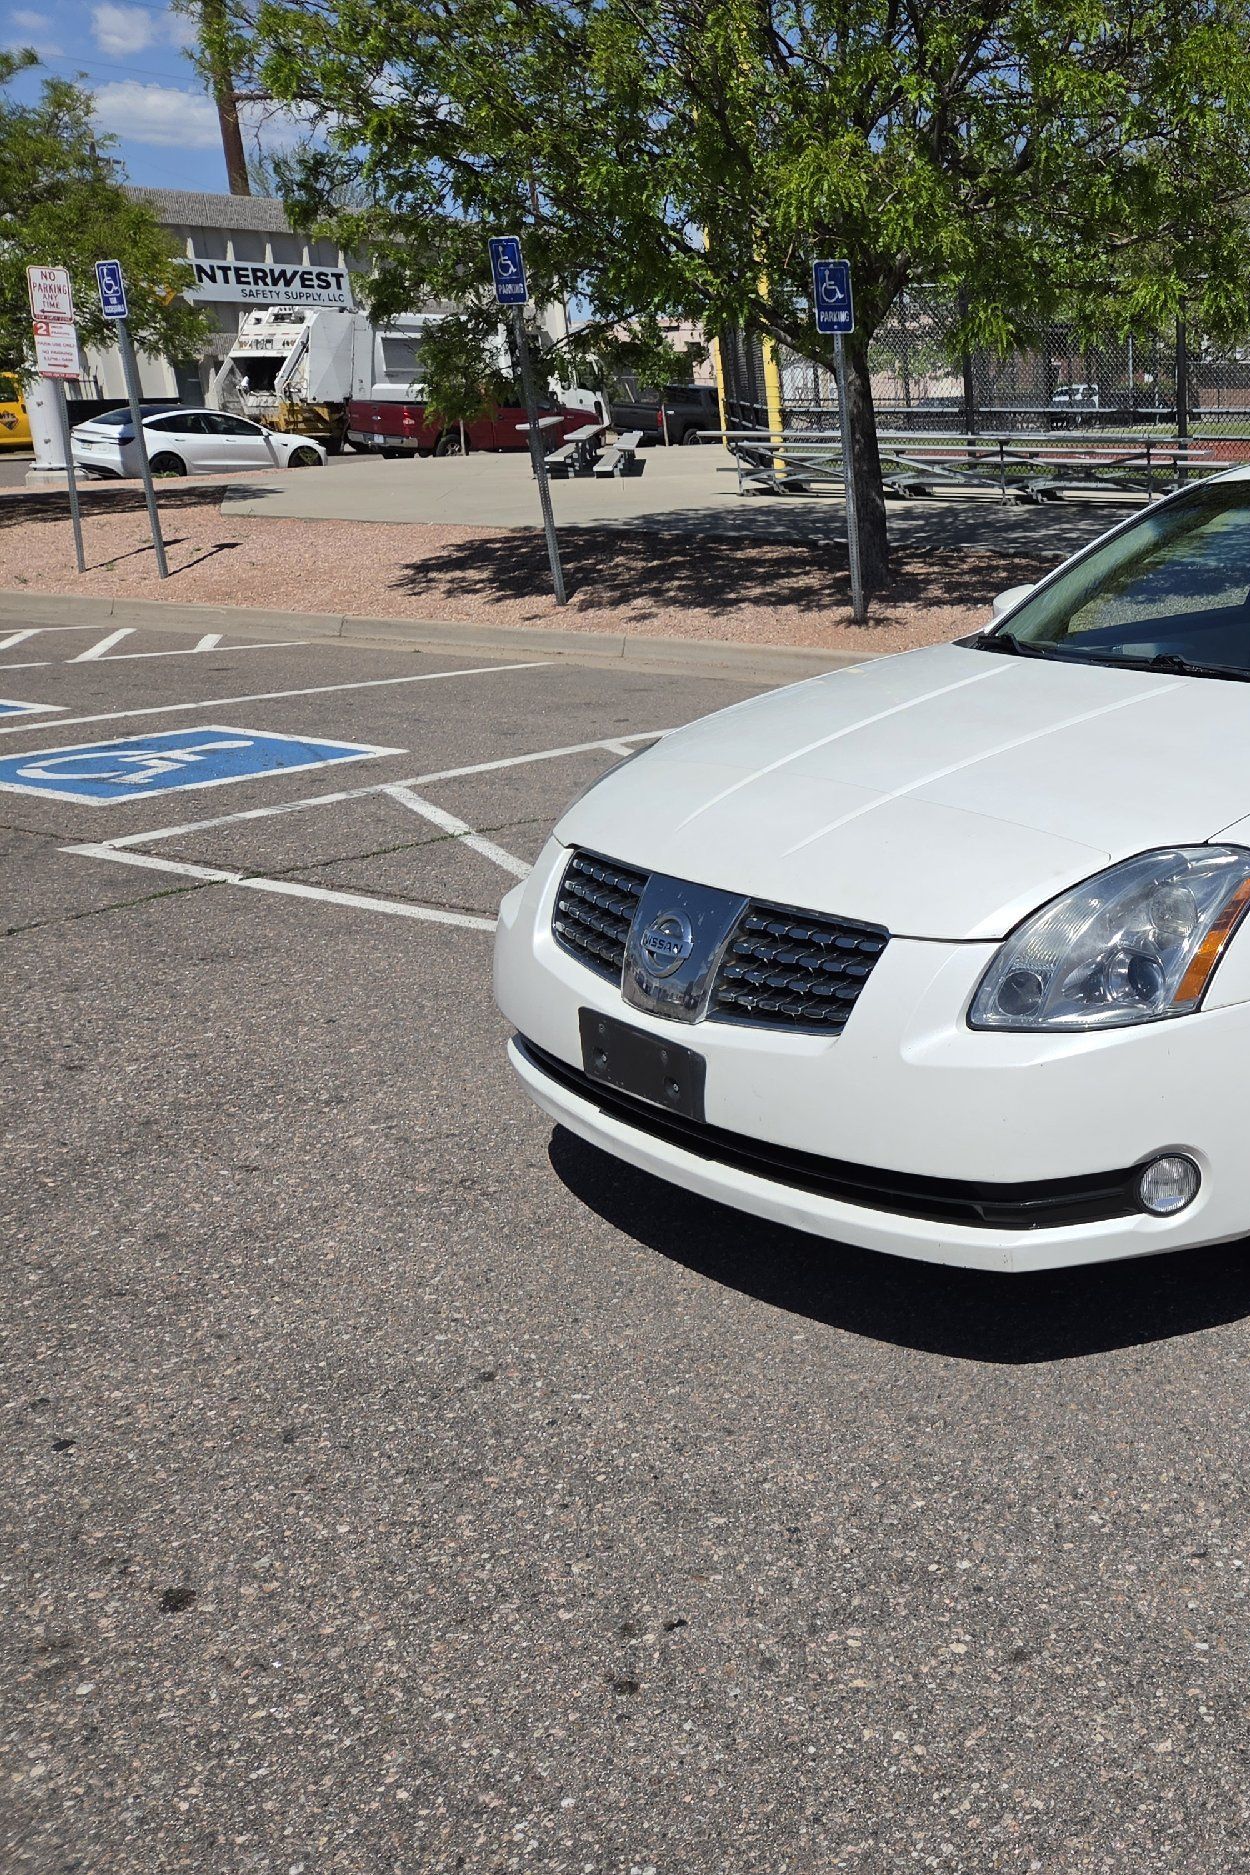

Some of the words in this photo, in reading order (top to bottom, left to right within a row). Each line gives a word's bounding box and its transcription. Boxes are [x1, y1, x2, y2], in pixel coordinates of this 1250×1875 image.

[40, 270, 56, 281] NO
[188, 264, 344, 290] NTERWEST
[32, 282, 67, 295] PARKING
[498, 283, 524, 295] PARKING
[241, 288, 280, 299] SAFETY
[284, 291, 325, 302] SUPPLY,
[328, 294, 344, 303] LLC
[43, 301, 60, 309] TIME
[820, 311, 850, 323] PARKING
[37, 323, 47, 335] 2
[643, 934, 683, 954] NISSAN
